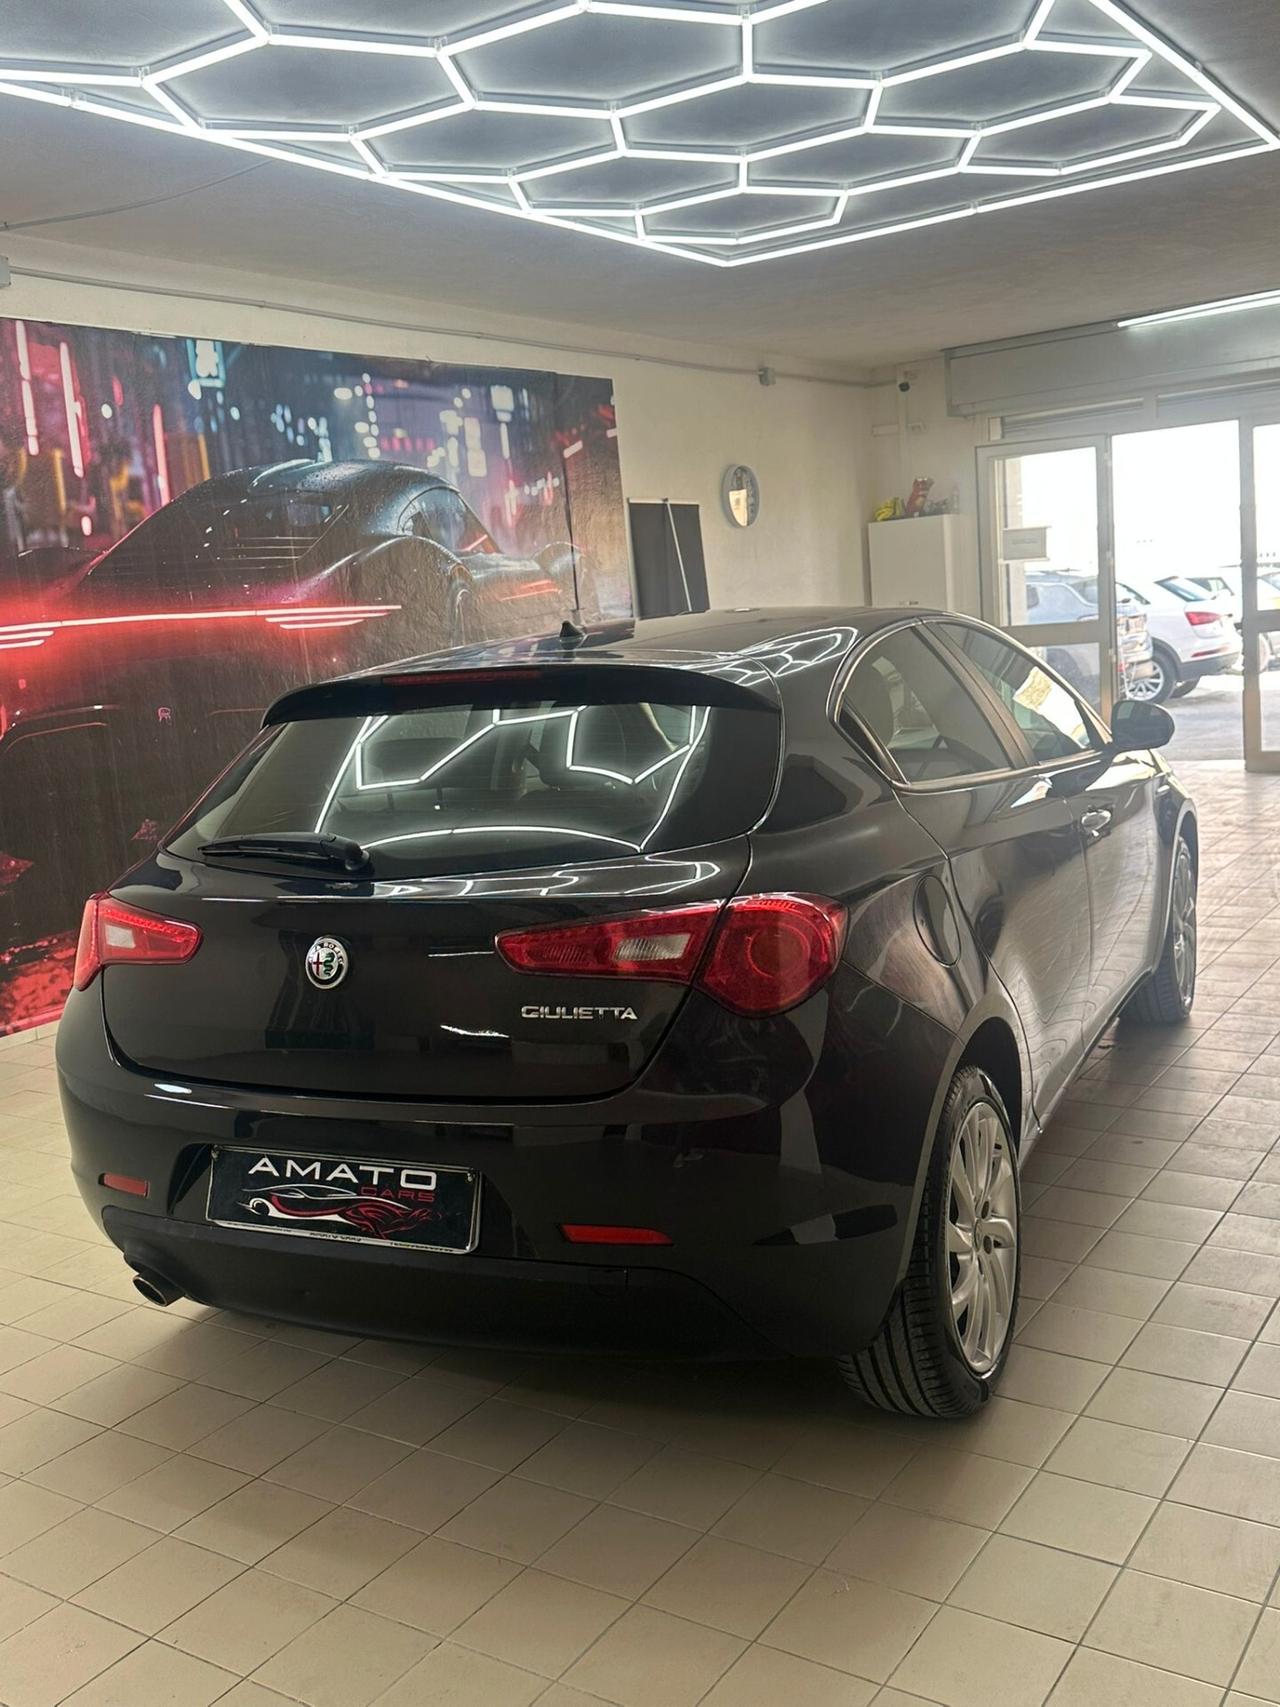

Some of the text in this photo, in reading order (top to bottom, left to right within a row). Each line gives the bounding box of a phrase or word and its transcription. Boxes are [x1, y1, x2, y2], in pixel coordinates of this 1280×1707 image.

[521, 1005, 638, 1020] GIULIETTA
[249, 1157, 437, 1190] AMATO
[360, 1186, 435, 1202] CARS
